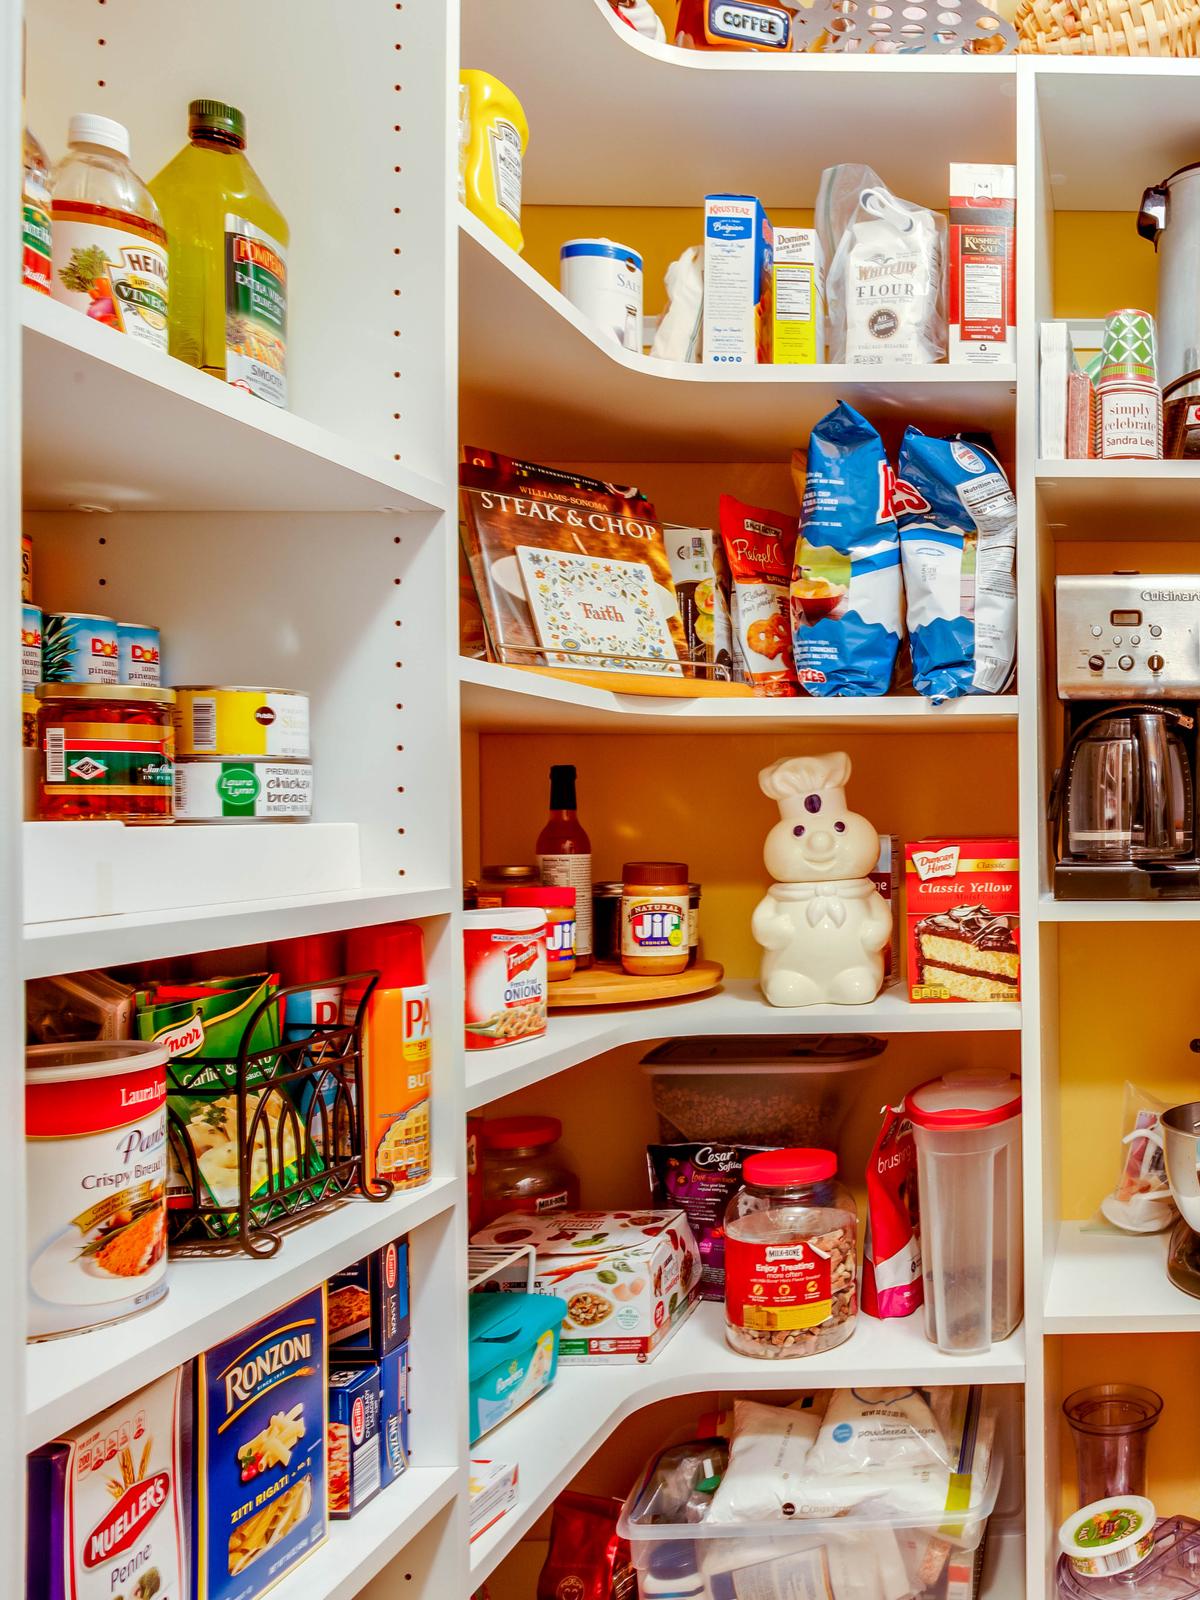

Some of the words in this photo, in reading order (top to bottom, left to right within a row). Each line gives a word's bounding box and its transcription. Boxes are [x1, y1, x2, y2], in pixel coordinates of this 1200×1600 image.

[723, 11, 777, 35] COFFEE
[709, 205, 750, 216] KRUSTEAZ
[777, 234, 809, 246] Domino
[964, 236, 1001, 249] KOSHER
[856, 284, 914, 298] FLOUR
[120, 286, 168, 313] VINE
[1109, 402, 1151, 419] simply
[1104, 417, 1156, 432] celebrate
[1106, 435, 1138, 447] Sandra
[1140, 436, 1155, 447] Lee
[519, 485, 608, 512] WILLIAMS-SONOMA
[481, 492, 565, 524] STEAK
[566, 509, 584, 528] &
[588, 513, 657, 541] CHOP
[732, 538, 774, 570] Pretzel
[577, 601, 625, 623] Faith
[21, 628, 41, 645] ole
[131, 644, 159, 661] Dole
[88, 667, 119, 677] pineap
[128, 672, 160, 681] pineap
[221, 778, 254, 789] Laura
[228, 786, 256, 798] Lynn
[918, 852, 955, 867] Duncan
[976, 861, 1007, 870] Classic
[926, 862, 953, 875] Hines
[919, 882, 966, 894] Classic
[970, 882, 1013, 894] Yellow
[634, 904, 679, 913] NATURAL
[634, 914, 679, 939] Jif
[504, 983, 542, 1002] ONIONS
[405, 997, 431, 1039] PA
[407, 1074, 431, 1090] BUT
[123, 1118, 167, 1165] Pank
[695, 1146, 735, 1166] Cesar
[717, 1161, 742, 1173] Softies
[81, 1166, 131, 1191] Crispy
[768, 1248, 800, 1258] MILK-BONE
[755, 1263, 779, 1273] Enjoy
[779, 1262, 815, 1272] Treating
[225, 1333, 313, 1413] RONZONI
[857, 1428, 908, 1439] powdered
[230, 1500, 254, 1525] ZITI
[255, 1474, 290, 1508] RIGATI
[90, 1477, 166, 1562] MUELLER'S
[110, 1543, 152, 1593] Penne
